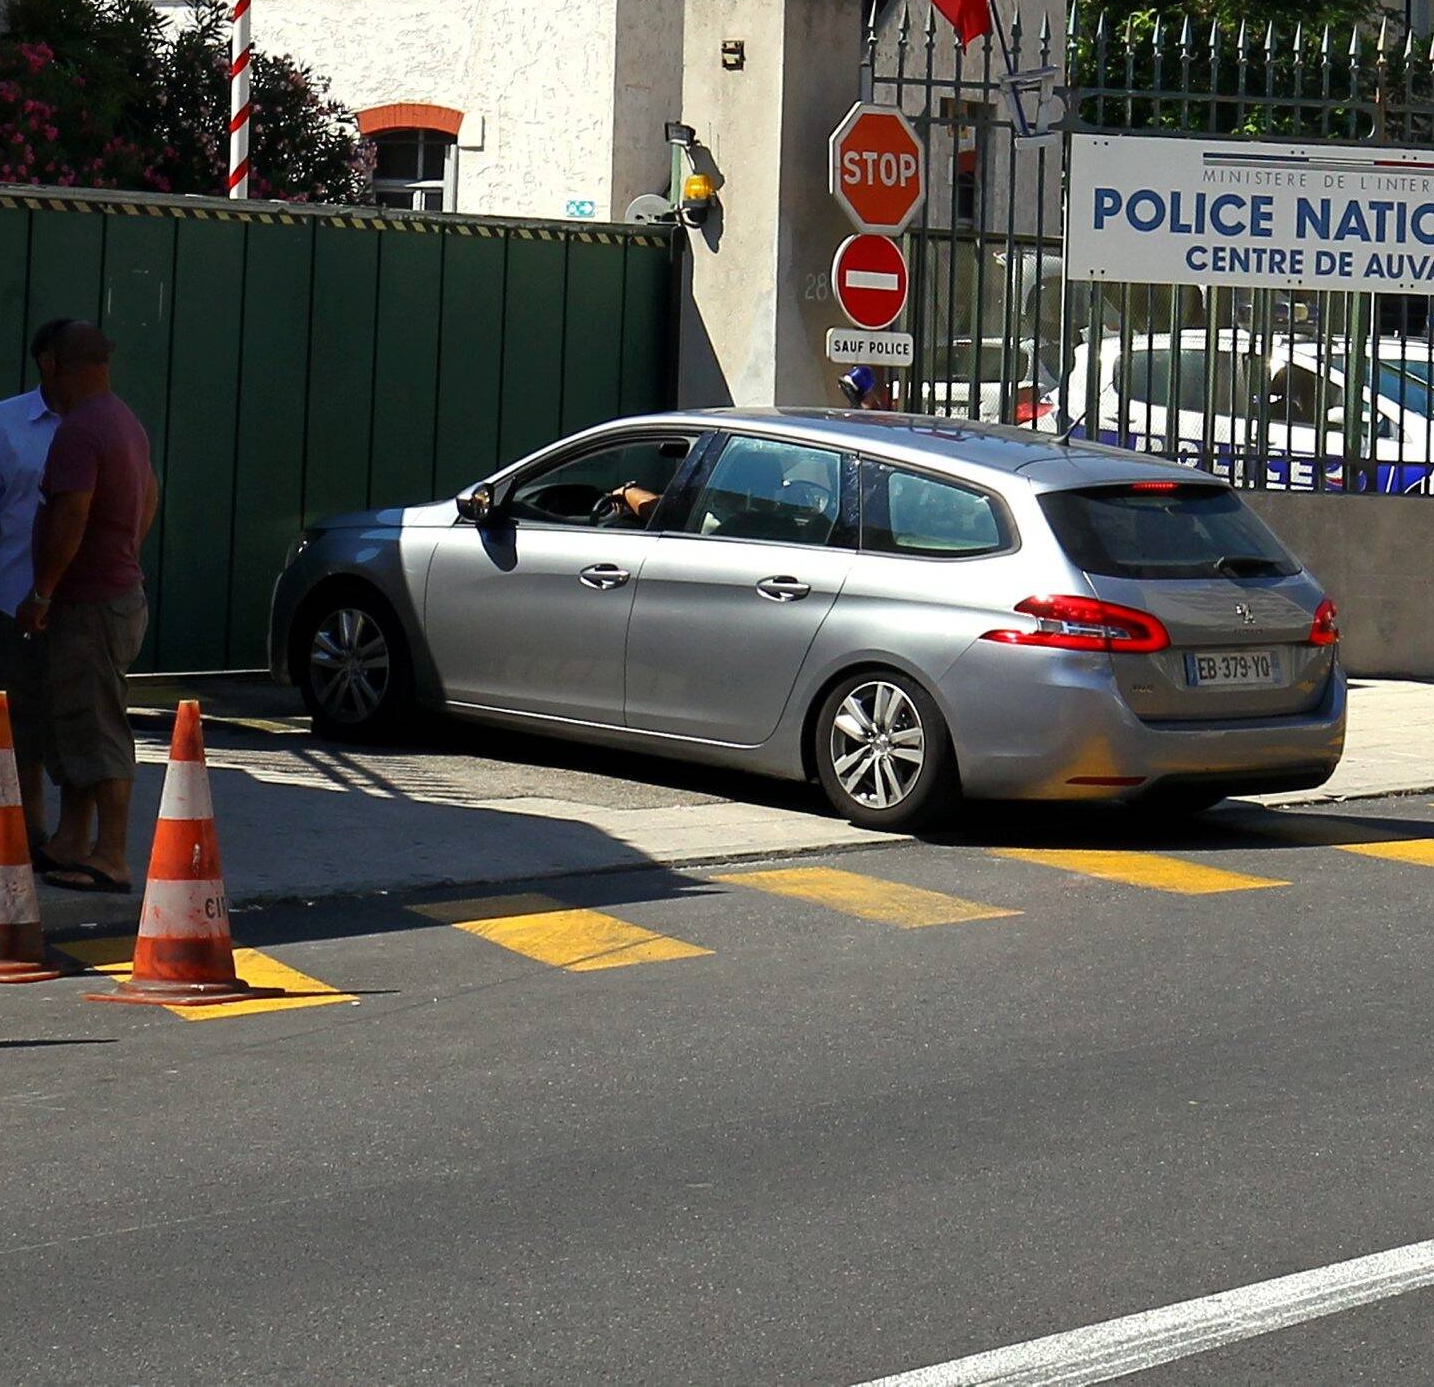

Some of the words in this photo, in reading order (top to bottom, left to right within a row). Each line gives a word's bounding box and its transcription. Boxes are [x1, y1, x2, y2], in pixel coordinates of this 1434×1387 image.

[843, 151, 916, 187] STOP
[1202, 169, 1307, 188] MINISTERE
[1324, 175, 1345, 189] DE
[1094, 187, 1274, 238] POLICE
[1185, 245, 1304, 275] CENTRE
[1315, 250, 1353, 278] DE
[834, 340, 864, 352] SAUF
[869, 343, 910, 355] POLICE
